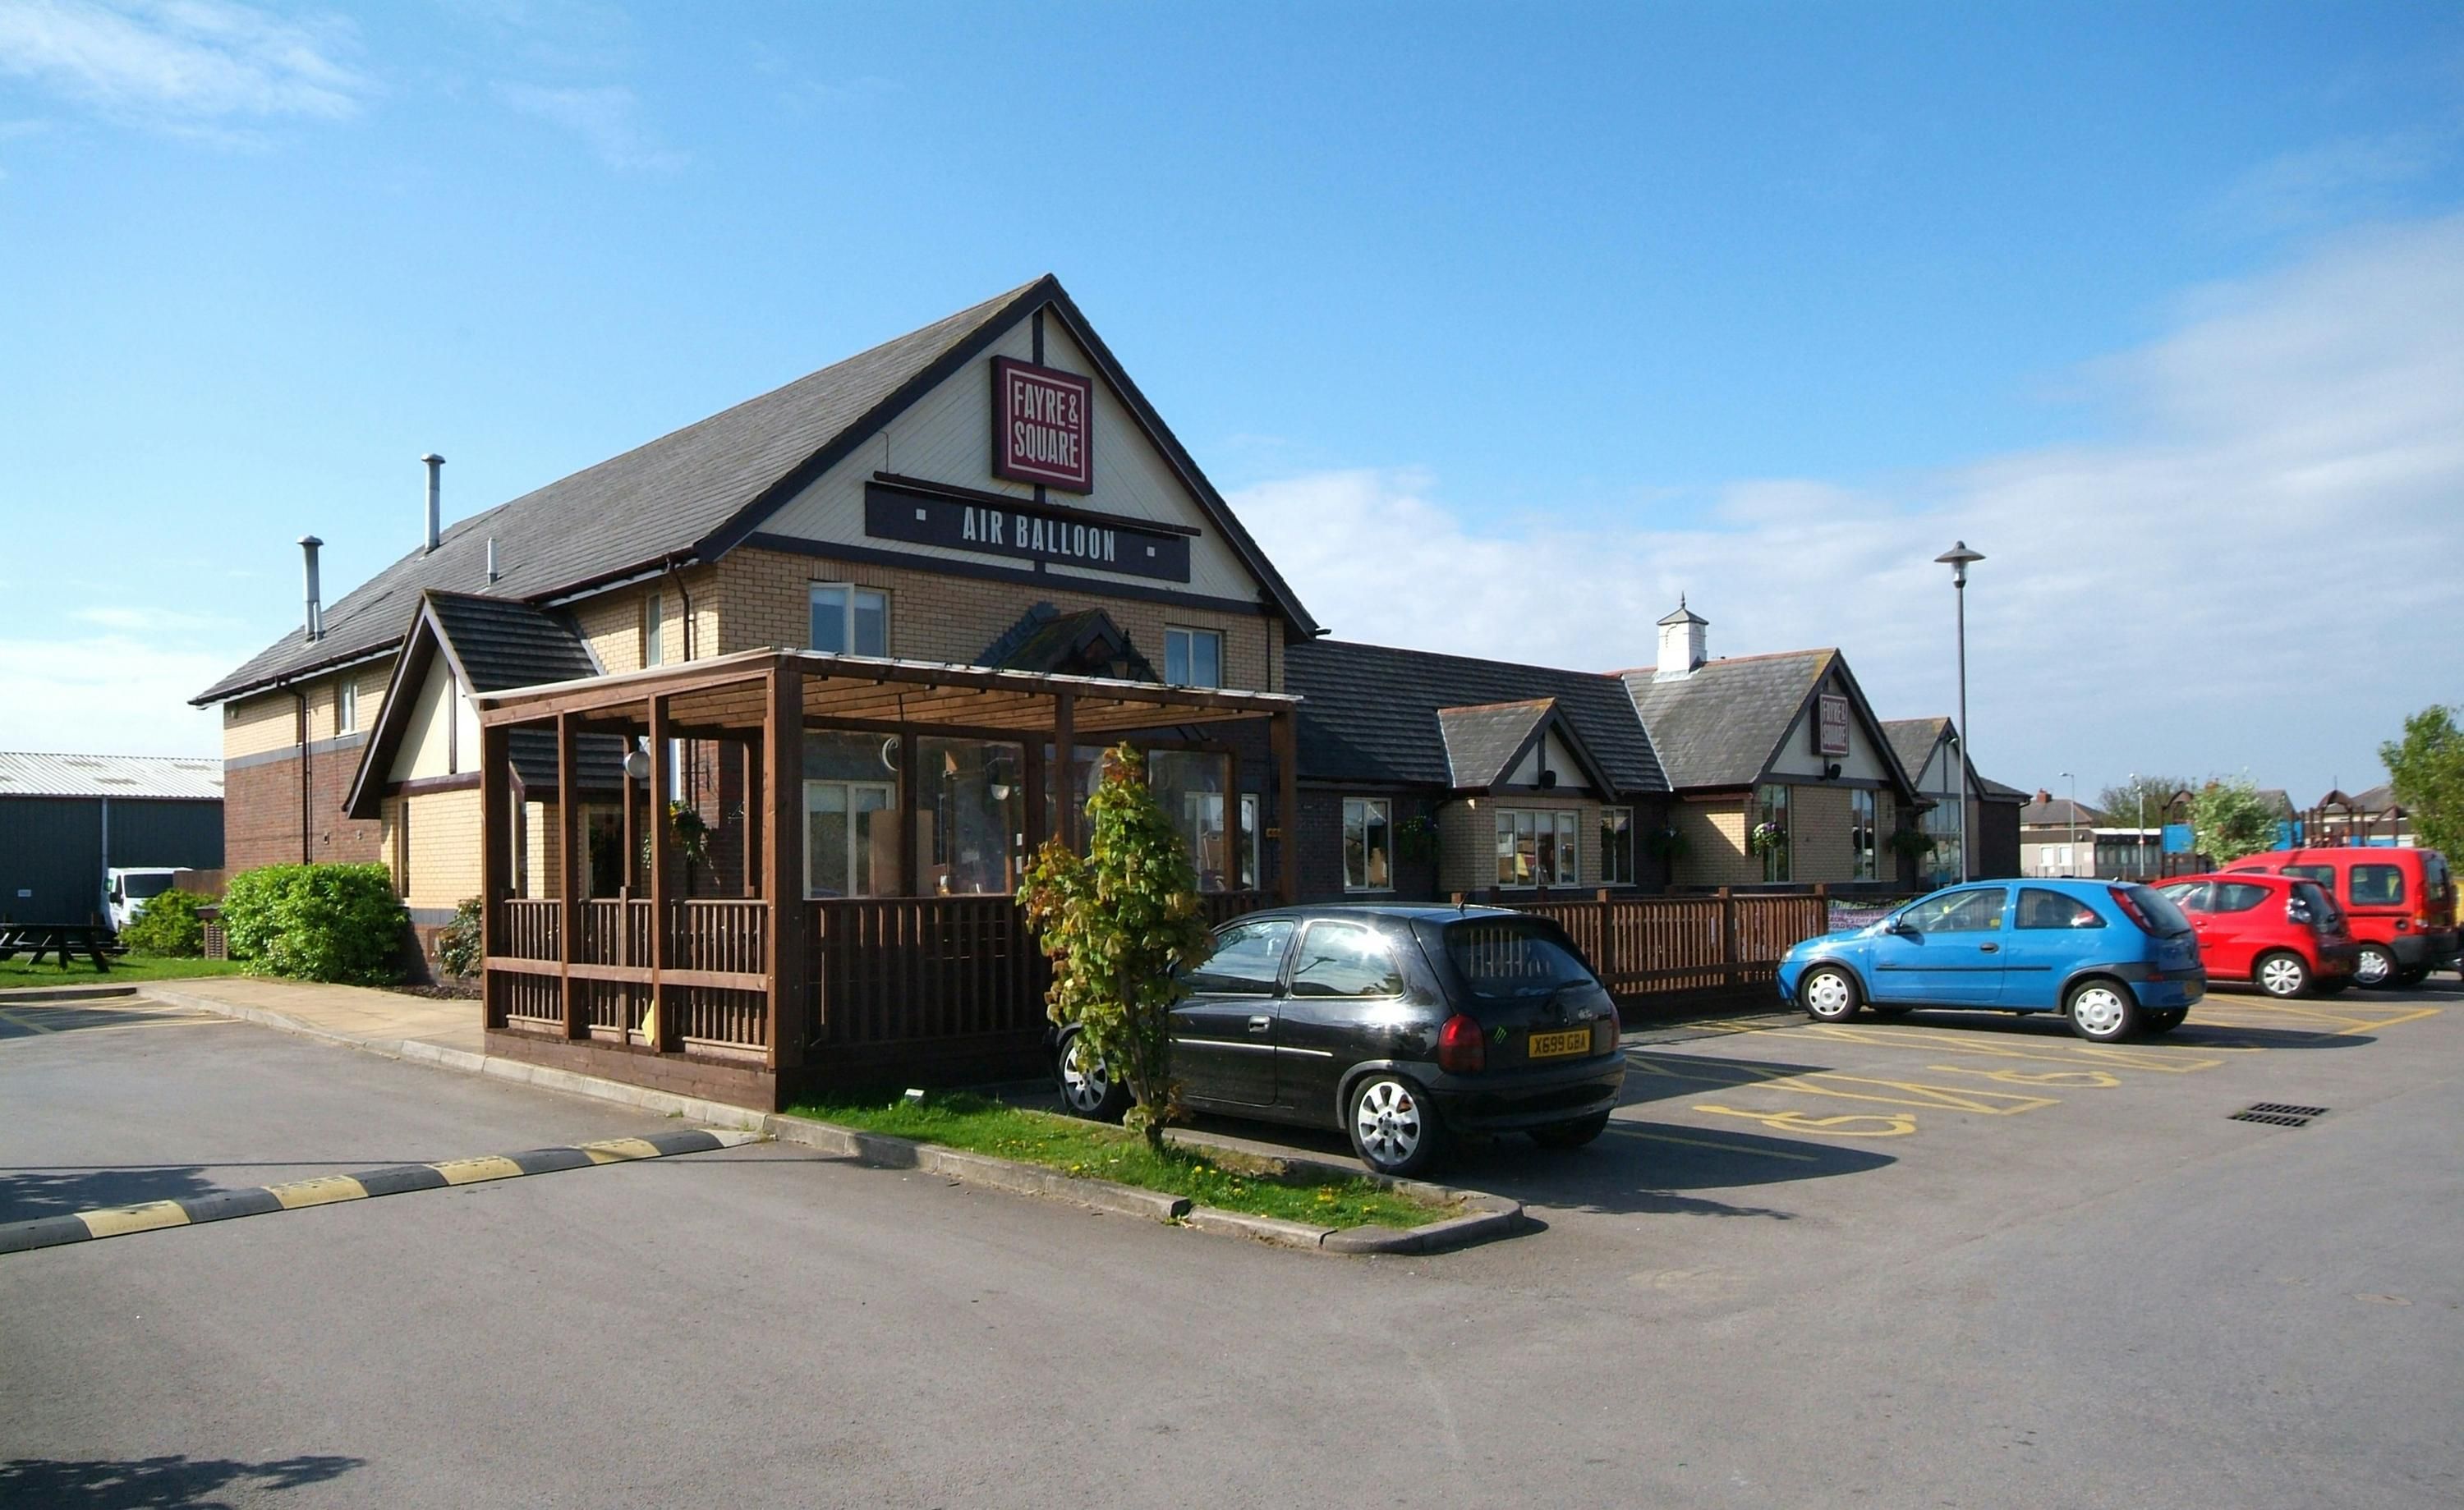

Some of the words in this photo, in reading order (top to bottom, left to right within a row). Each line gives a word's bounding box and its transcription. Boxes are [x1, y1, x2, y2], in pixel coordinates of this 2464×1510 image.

[1014, 381, 1066, 427] FAYRE
[1068, 393, 1078, 427] &
[1014, 421, 1078, 469] SQUARE
[963, 507, 1004, 545] AIR
[1016, 515, 1116, 562] BALLOON
[1534, 1034, 1565, 1055] X699
[1566, 1031, 1588, 1051] GBA
